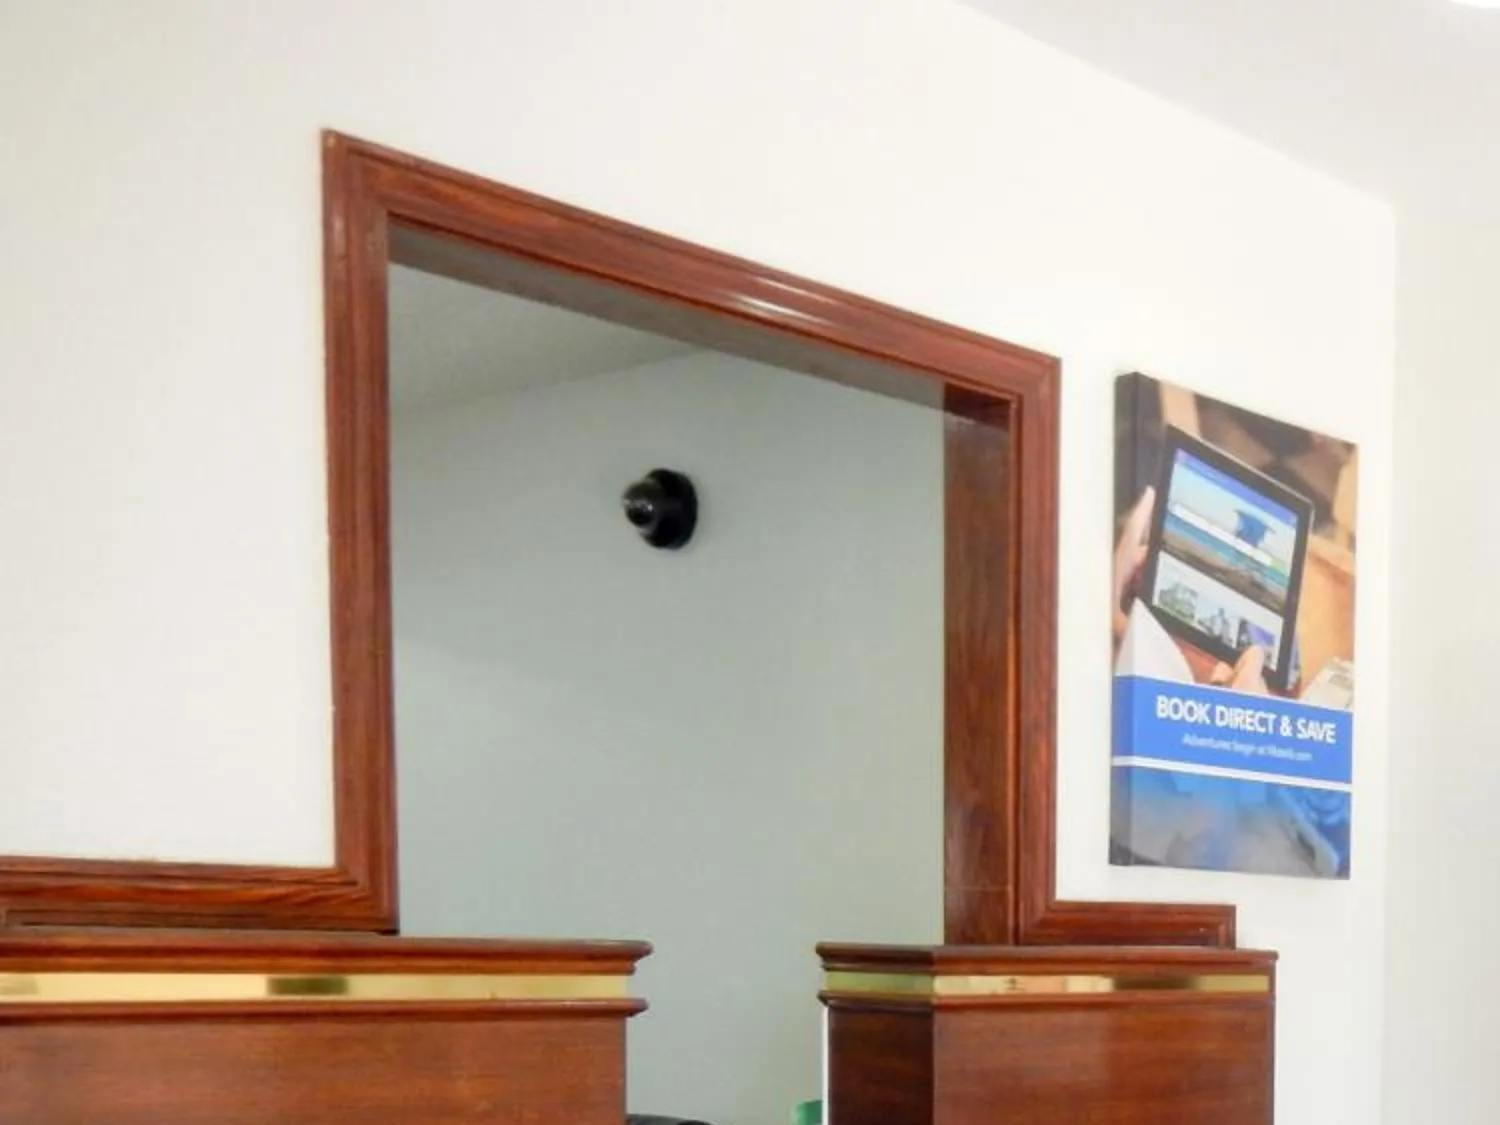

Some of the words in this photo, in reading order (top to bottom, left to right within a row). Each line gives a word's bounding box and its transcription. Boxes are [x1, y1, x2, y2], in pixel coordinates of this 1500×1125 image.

[1156, 695, 1210, 725] BOOK
[1215, 705, 1277, 735] DIRECT
[1280, 715, 1293, 738] &
[1297, 718, 1337, 744] SAVE
